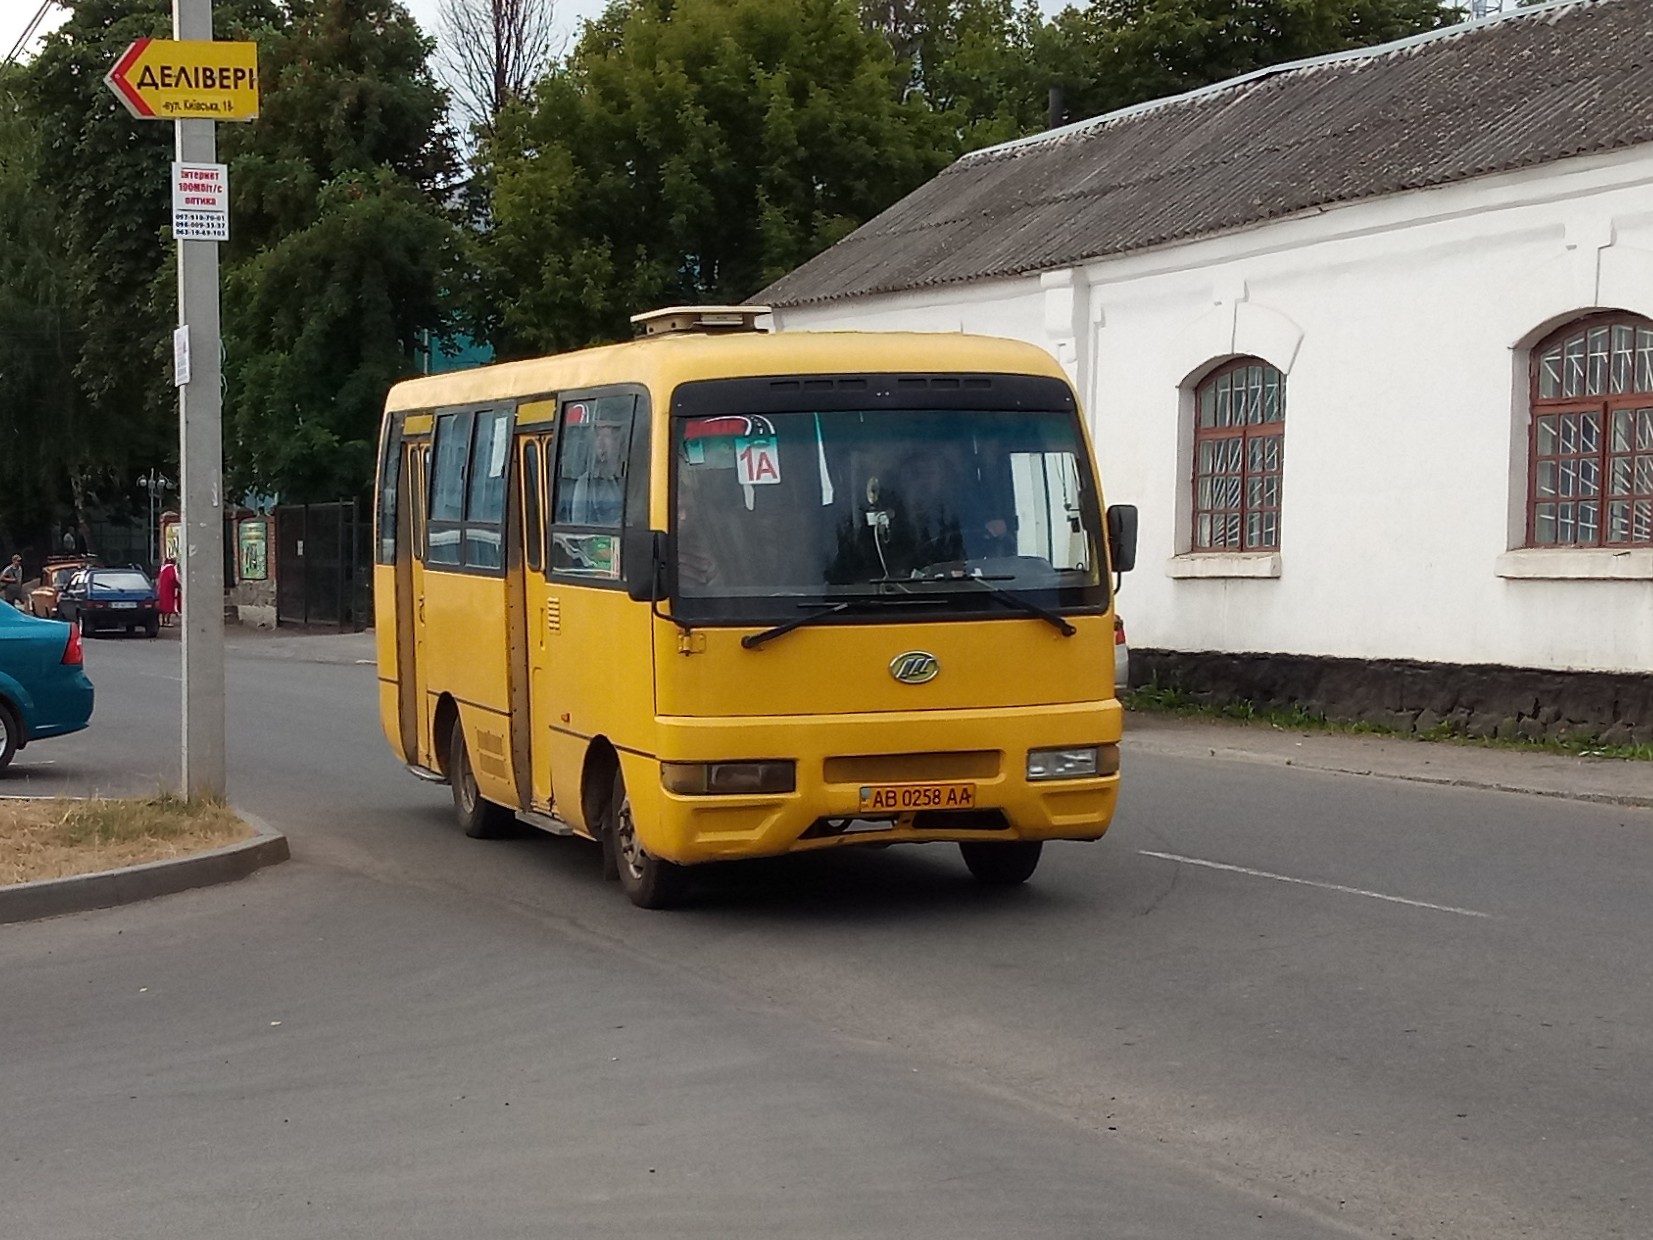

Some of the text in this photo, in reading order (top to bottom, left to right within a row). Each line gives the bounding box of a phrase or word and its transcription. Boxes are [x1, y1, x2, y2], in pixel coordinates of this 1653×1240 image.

[136, 64, 254, 90] ДЕЛІВЕРІ
[872, 787, 970, 808] AB 0258 AA
